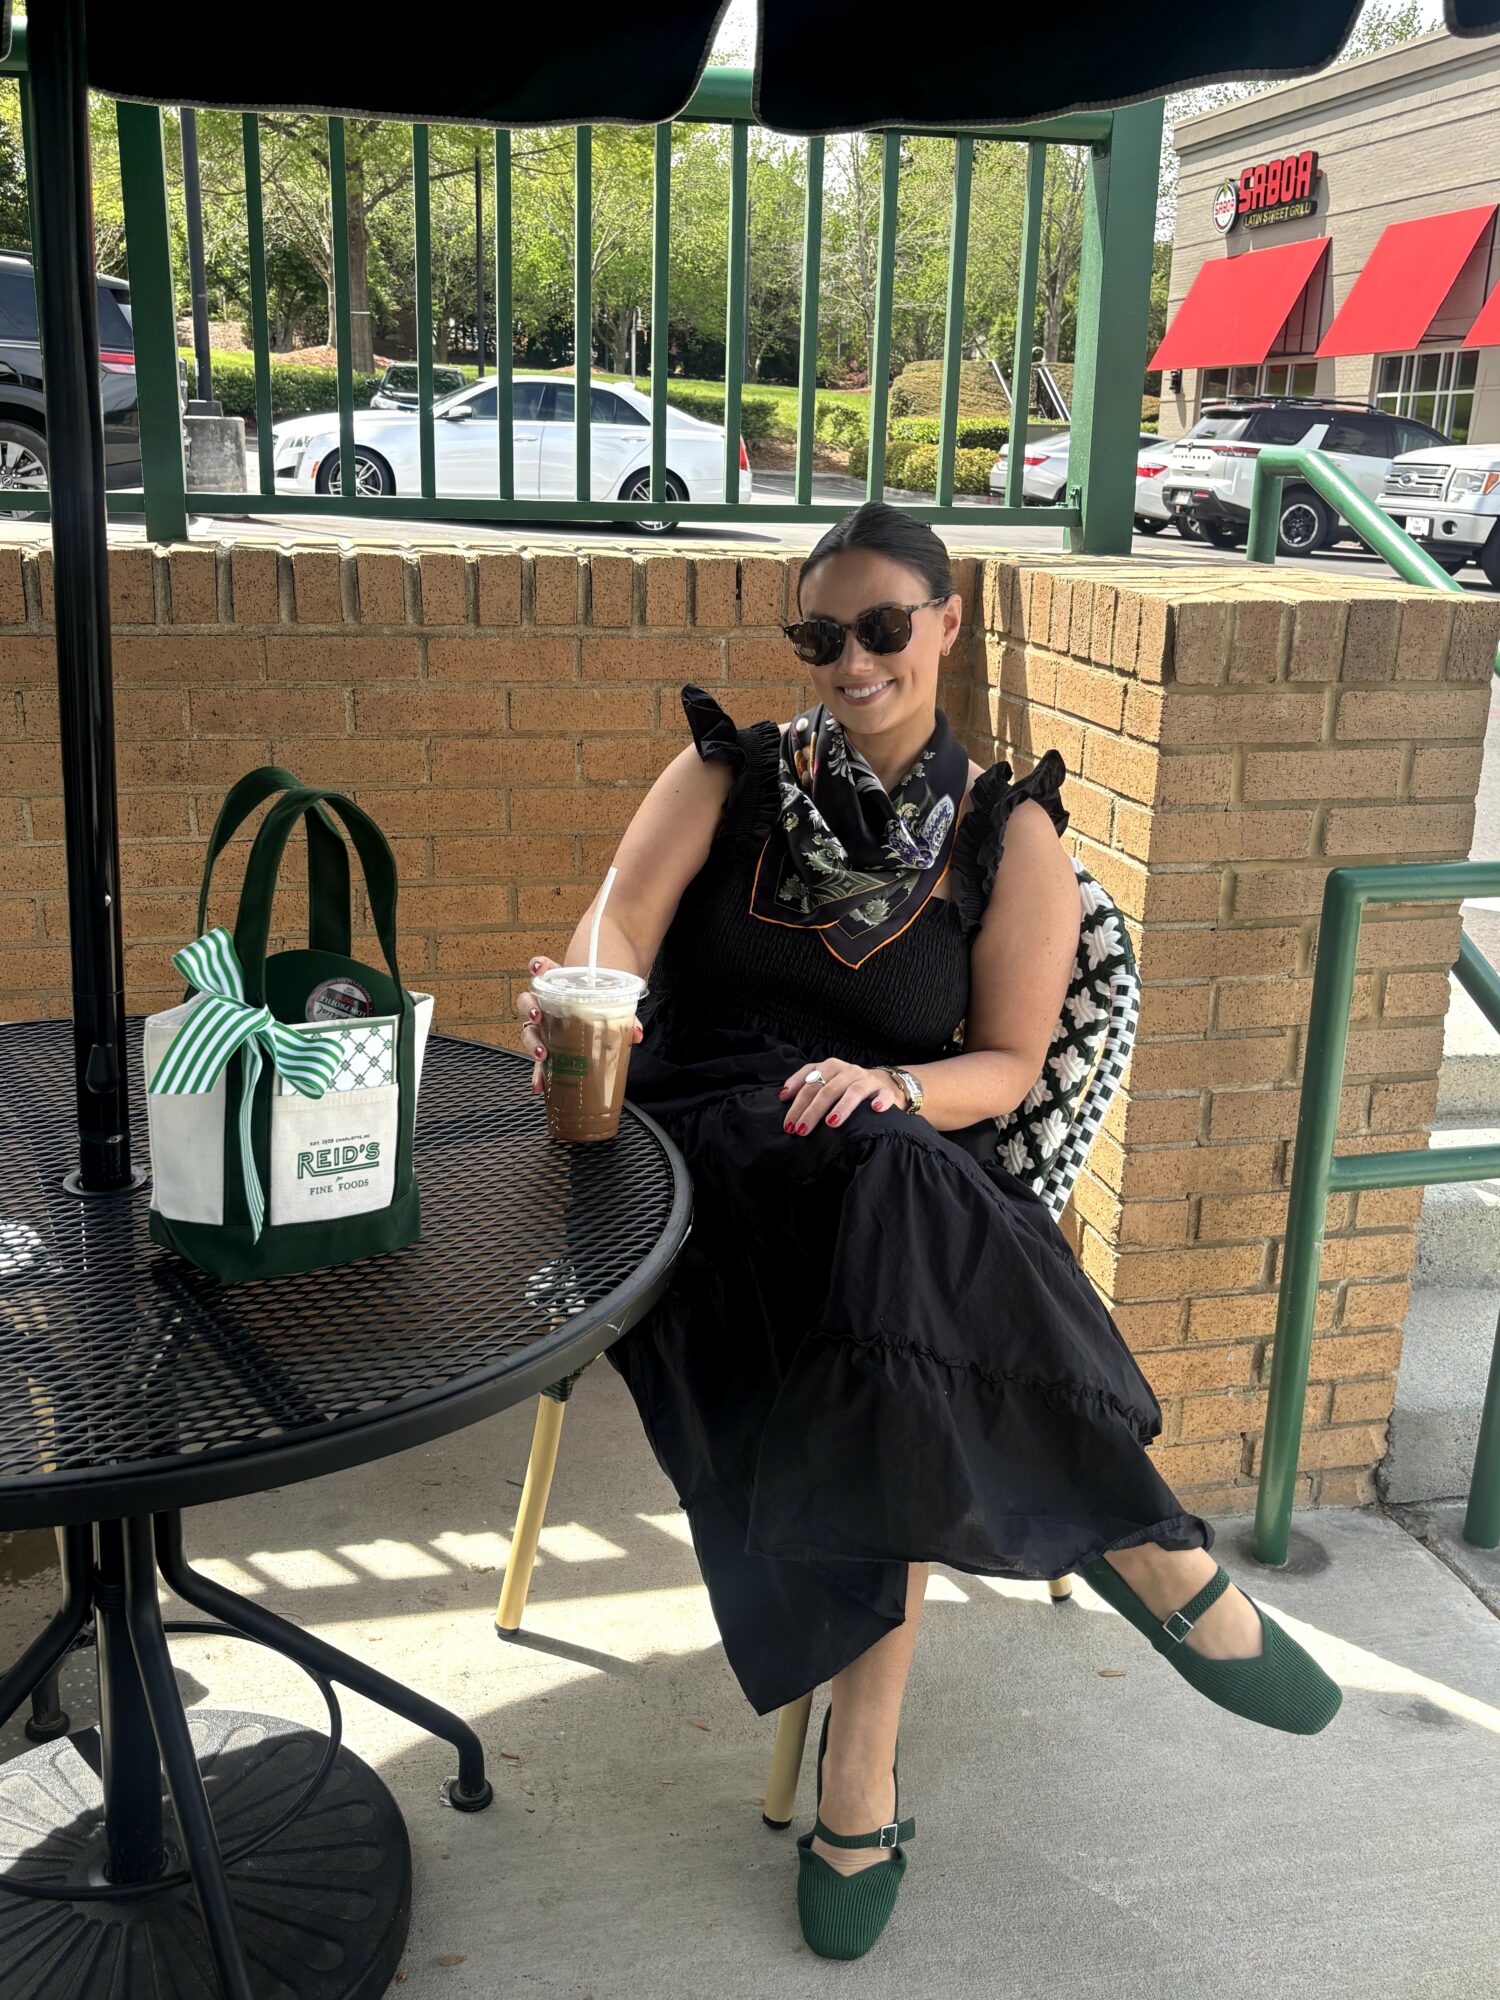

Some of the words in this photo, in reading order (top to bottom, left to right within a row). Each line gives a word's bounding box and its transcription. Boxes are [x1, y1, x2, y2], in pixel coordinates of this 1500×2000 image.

[1238, 151, 1313, 213] SABOR
[1245, 210, 1262, 226] LATIN
[1263, 206, 1288, 222] STREET
[1289, 202, 1311, 217] GRILL
[297, 1141, 381, 1180] REID'S
[309, 1184, 334, 1196] FINE
[338, 1179, 369, 1192] FOODS
